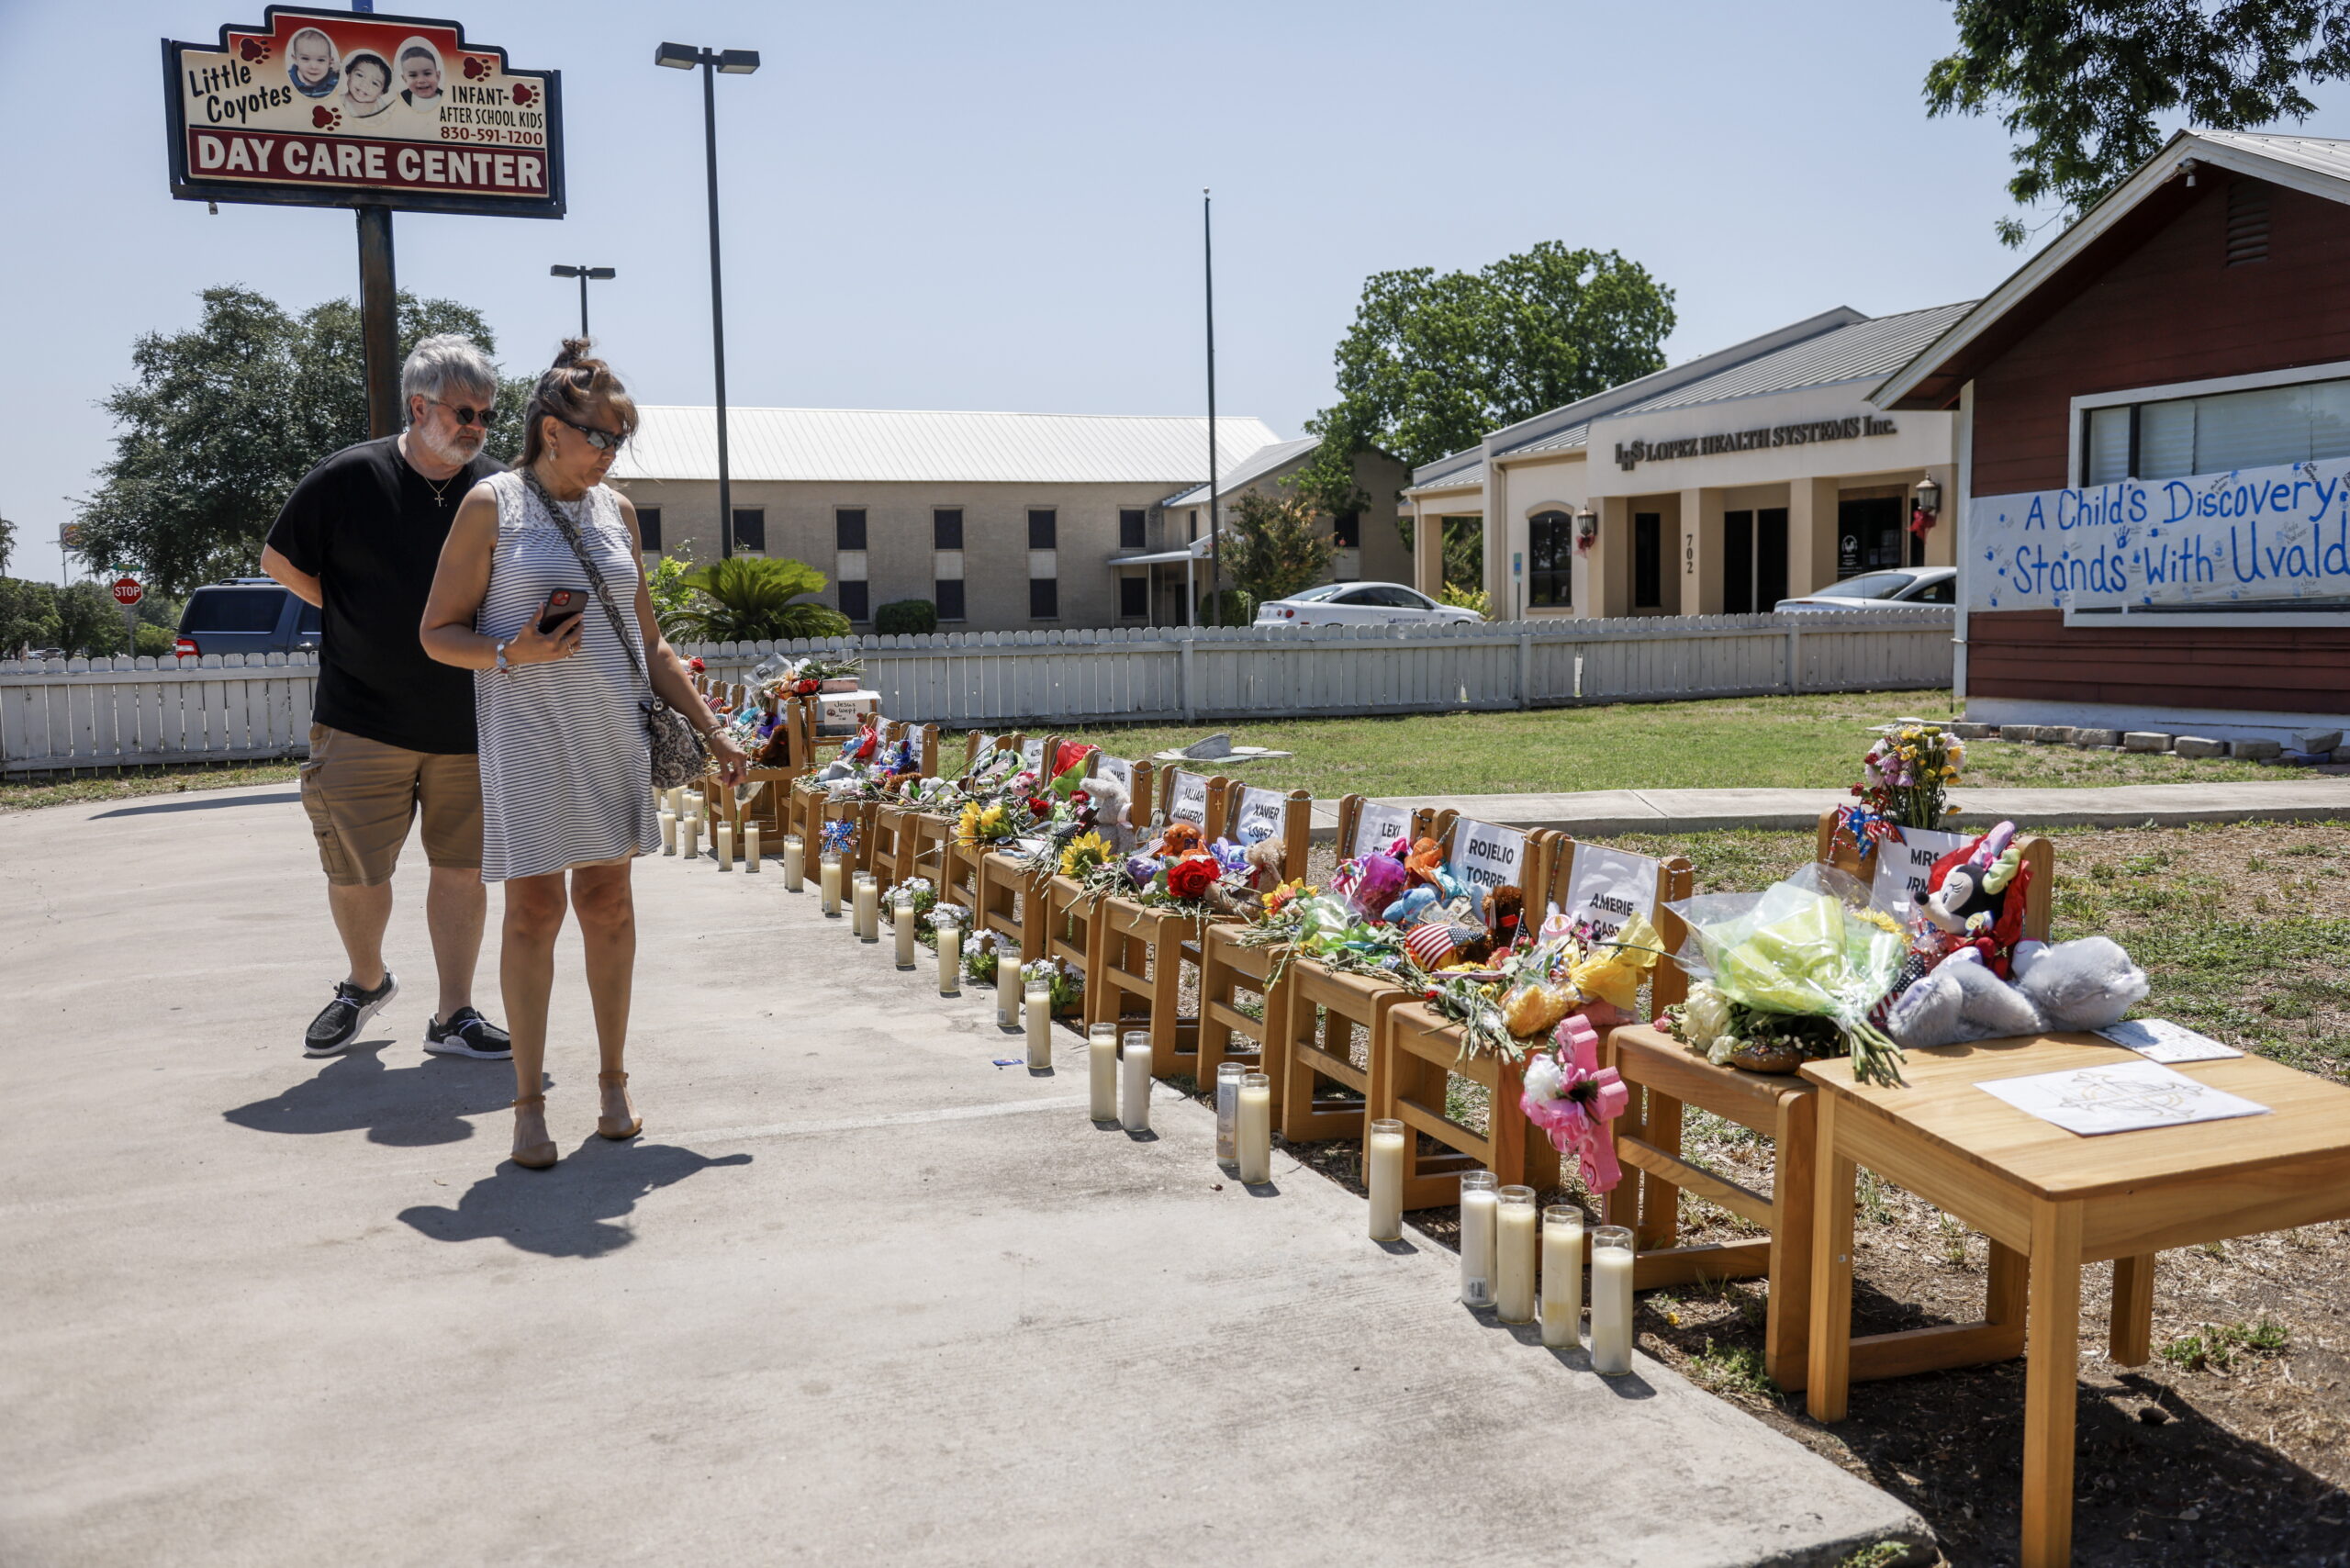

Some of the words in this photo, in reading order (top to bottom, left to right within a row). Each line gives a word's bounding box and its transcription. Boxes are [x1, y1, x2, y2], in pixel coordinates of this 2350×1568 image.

[188, 59, 252, 97] Little
[206, 84, 292, 124] Coyotes
[452, 85, 509, 106] INFANT-
[440, 106, 473, 125] AFTER
[476, 108, 517, 128] SCHOOL
[520, 111, 543, 129] KIDS
[441, 126, 543, 145] 830-591-1200
[197, 135, 275, 173] DAY
[283, 140, 386, 179] CARE
[397, 149, 542, 188] CENTER
[1645, 438, 1698, 462] LOPEZ
[1700, 428, 1771, 455] HEALTH
[1773, 416, 1861, 447] SYSTEMS
[1863, 415, 1897, 437] Inc.
[2025, 495, 2045, 530] A
[2058, 484, 2147, 530] Child's
[2163, 477, 2338, 522] Discovery
[2013, 544, 2127, 594] Stands
[2144, 534, 2213, 585] With
[2231, 510, 2350, 583] Uvald
[115, 586, 140, 597] STOP
[1253, 803, 1281, 820] XAVIER
[1382, 823, 1401, 838] LEXI
[1469, 839, 1515, 865] ROJELIO
[1589, 893, 1634, 916] AMERIE
